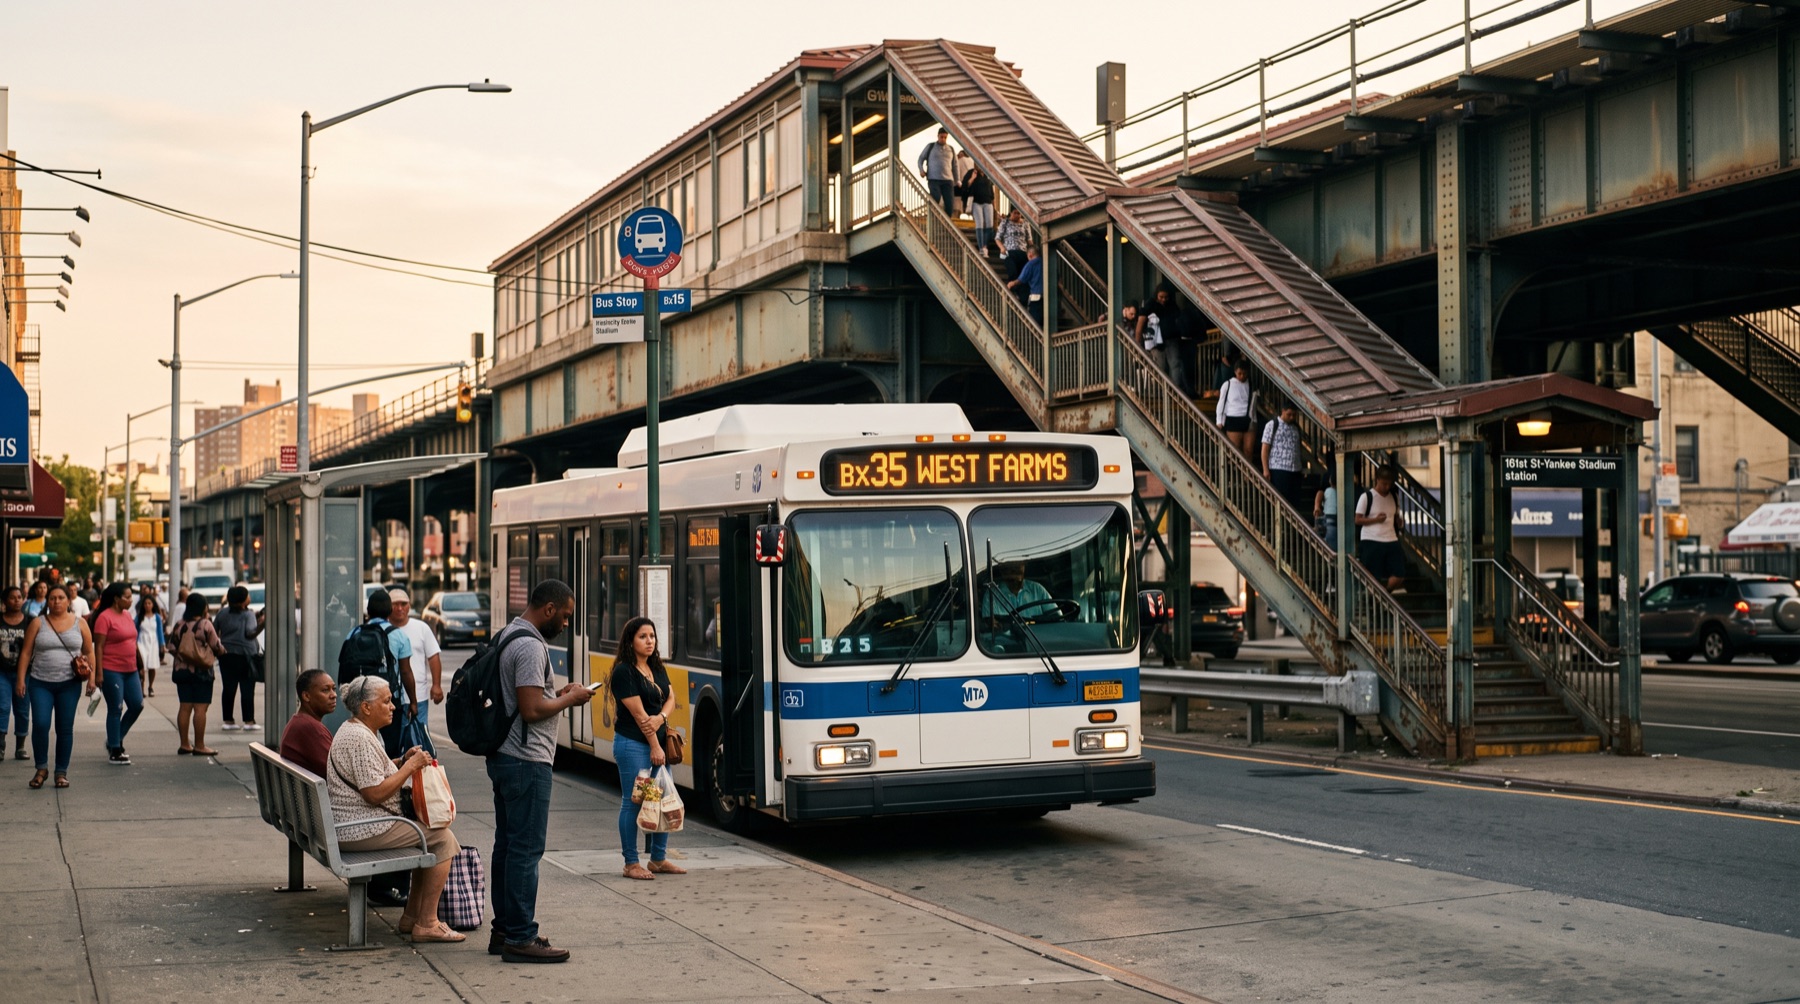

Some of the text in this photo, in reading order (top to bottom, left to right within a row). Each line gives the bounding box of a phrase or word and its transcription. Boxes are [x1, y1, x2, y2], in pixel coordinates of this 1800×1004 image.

[595, 296, 637, 308] Bus Stop
[663, 293, 685, 305] Bx15
[840, 452, 1068, 487] Bx35 WEST FARMS
[1504, 458, 1617, 470] 161st St-Yankee Stadium
[1505, 470, 1538, 481] station
[962, 686, 985, 702] MTA
